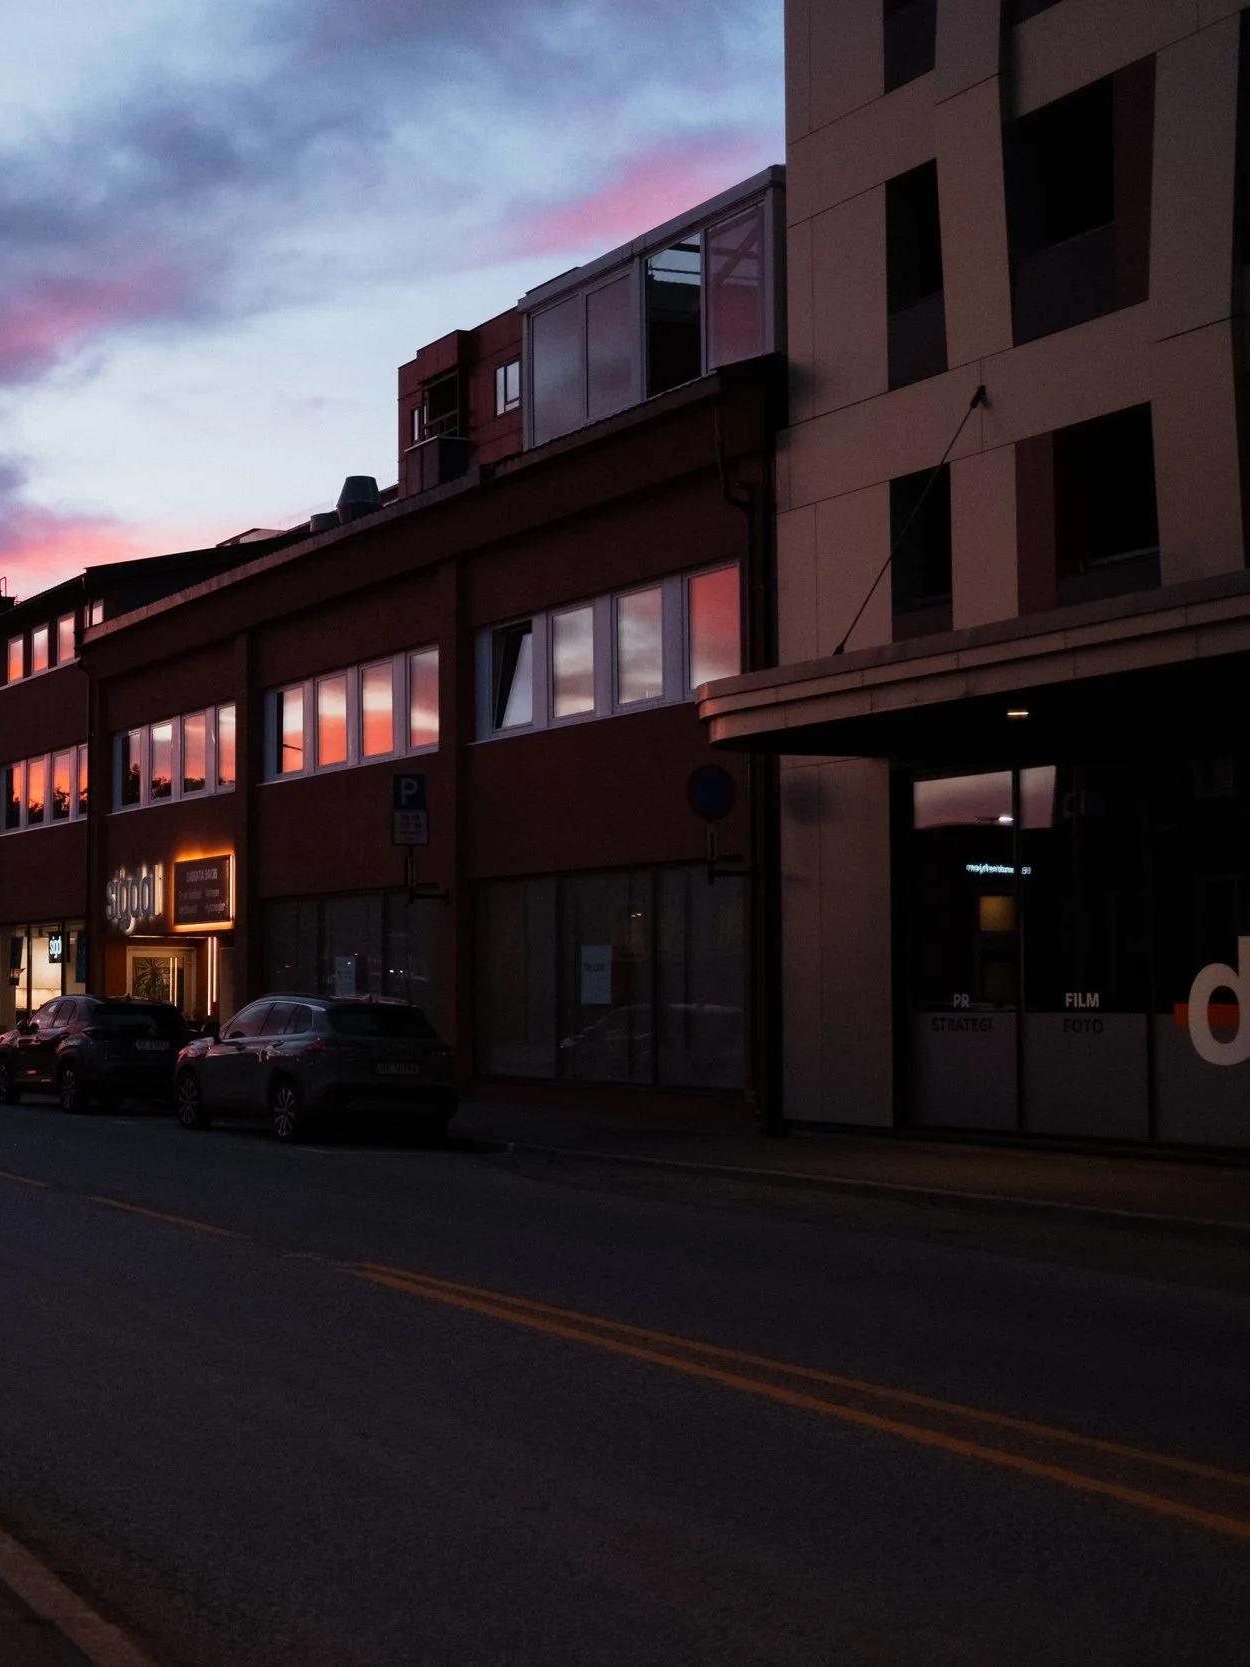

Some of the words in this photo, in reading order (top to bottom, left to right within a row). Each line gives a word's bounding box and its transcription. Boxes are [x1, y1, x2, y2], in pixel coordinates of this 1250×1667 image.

[400, 777, 419, 806] P
[952, 993, 971, 1009] PR
[1064, 992, 1100, 1009] FILM
[931, 1017, 993, 1033] STRATEGI
[1063, 1018, 1104, 1034] FOTO
